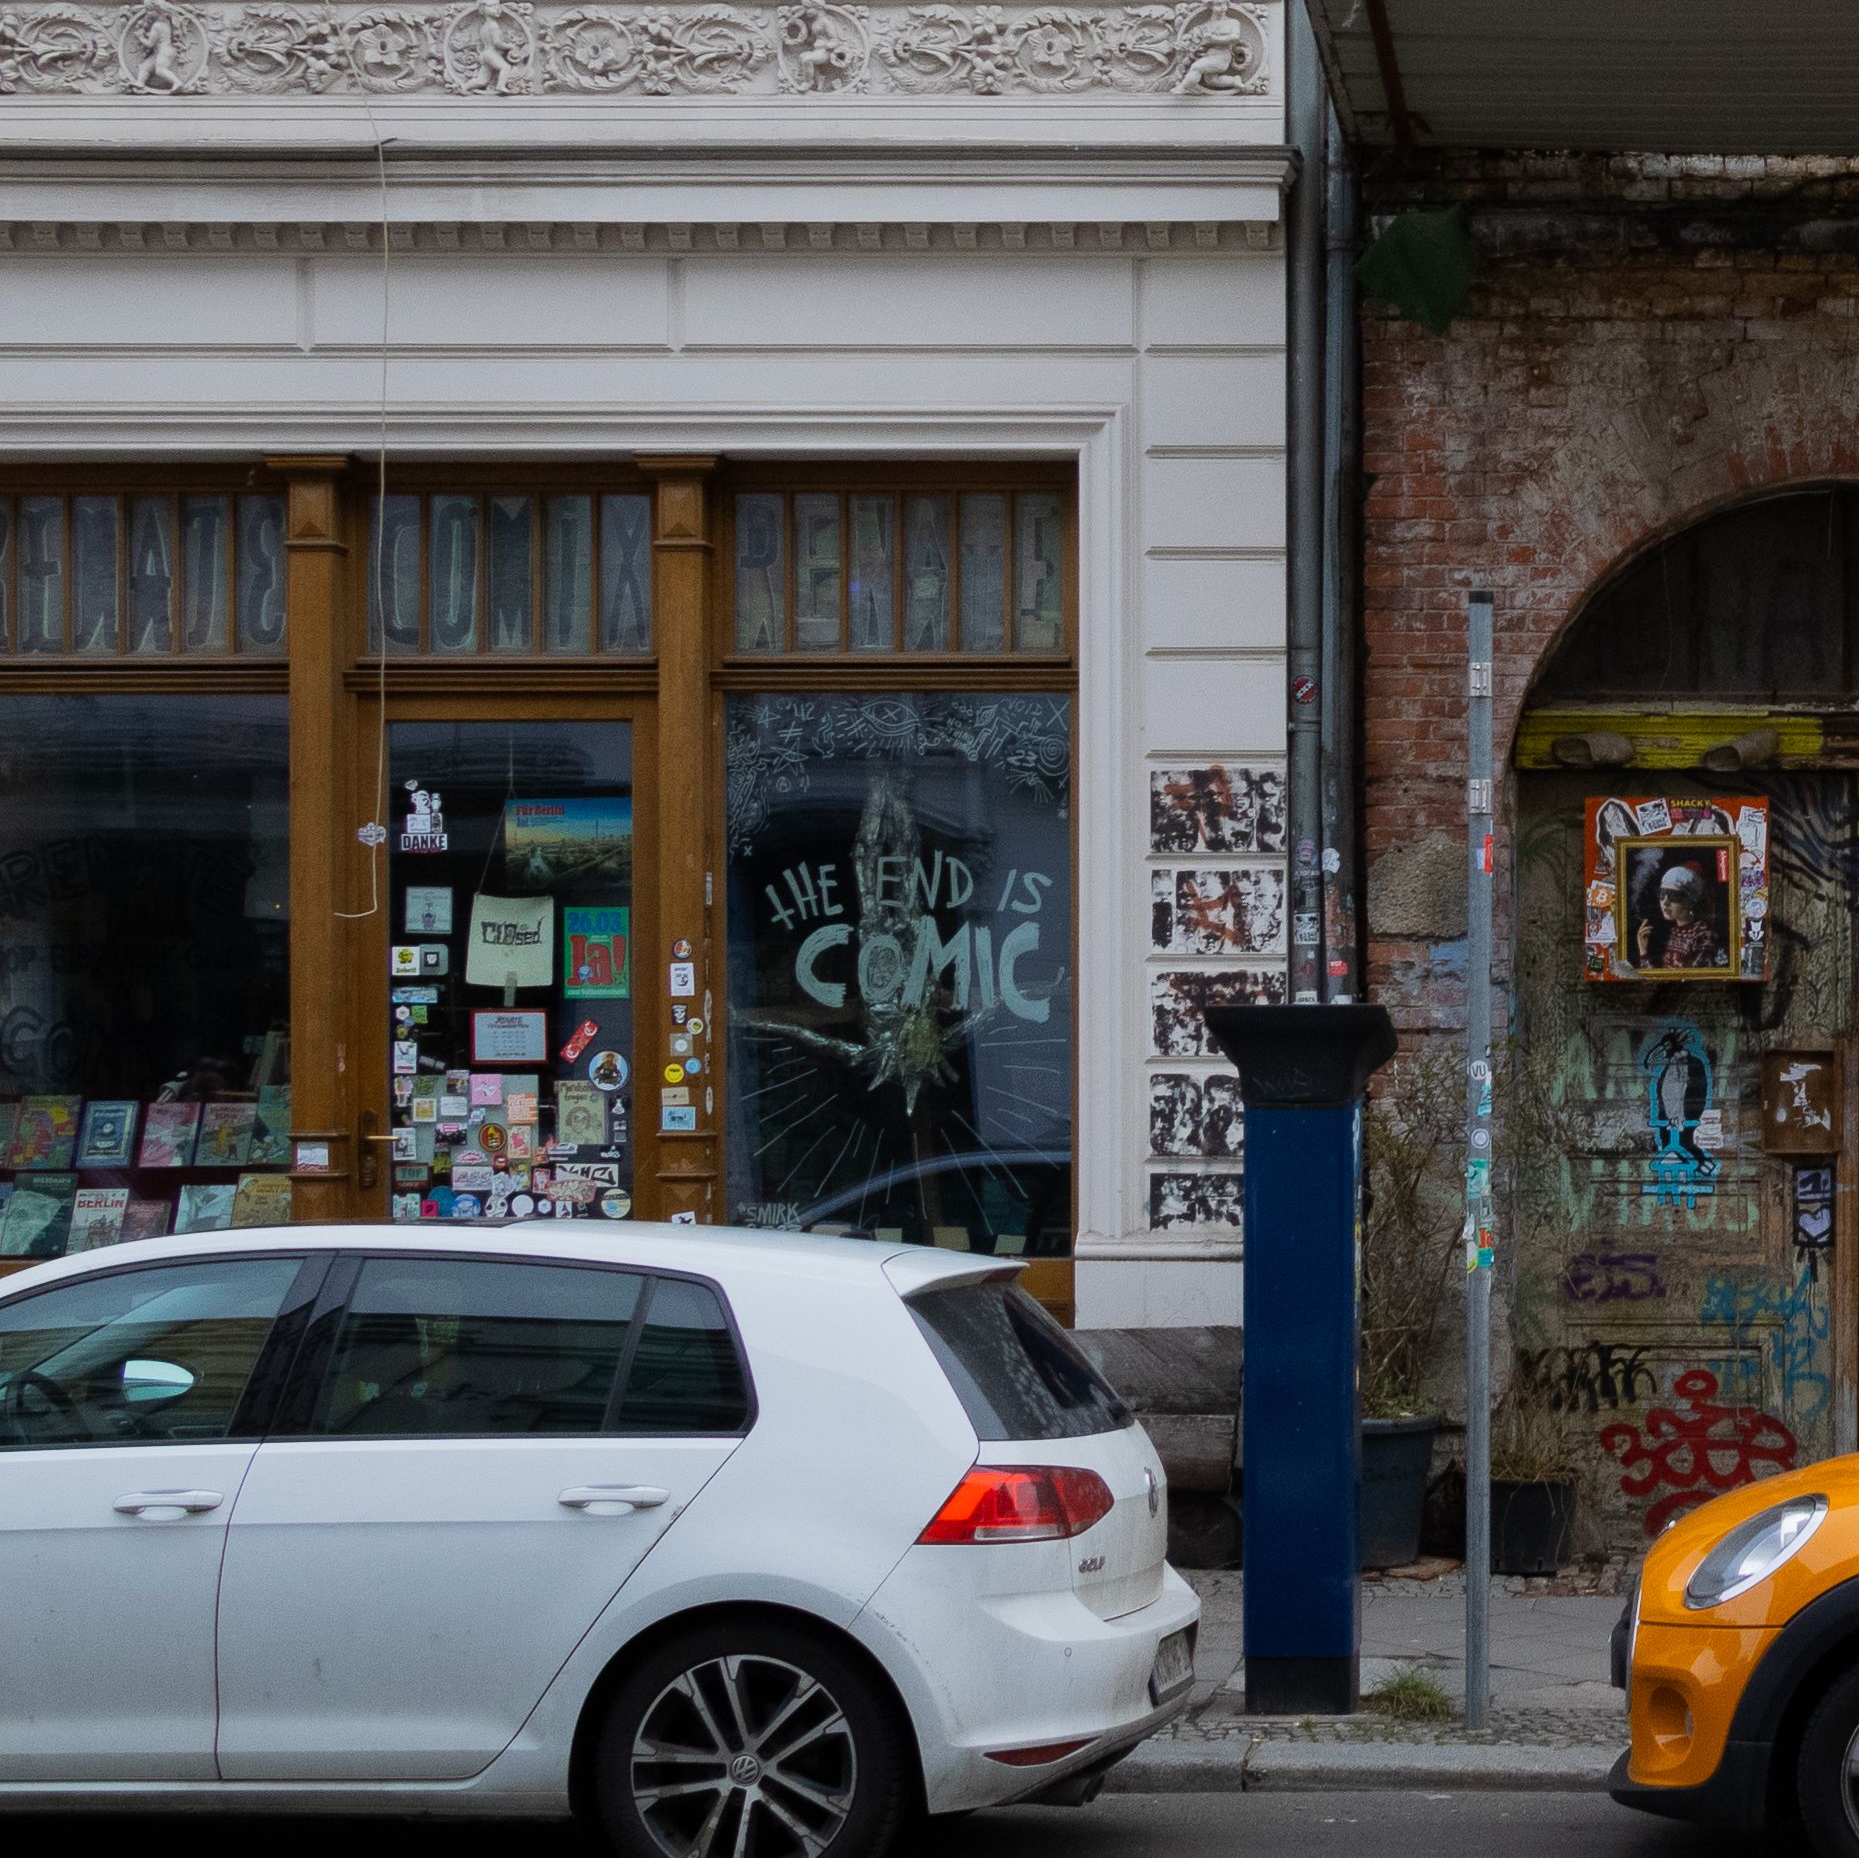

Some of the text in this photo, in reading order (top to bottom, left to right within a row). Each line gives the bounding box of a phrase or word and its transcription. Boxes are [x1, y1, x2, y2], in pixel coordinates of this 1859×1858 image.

[403, 835, 445, 849] DANKE
[877, 849, 974, 910] END
[996, 869, 1053, 914] IS
[795, 915, 1050, 1023] COMIC
